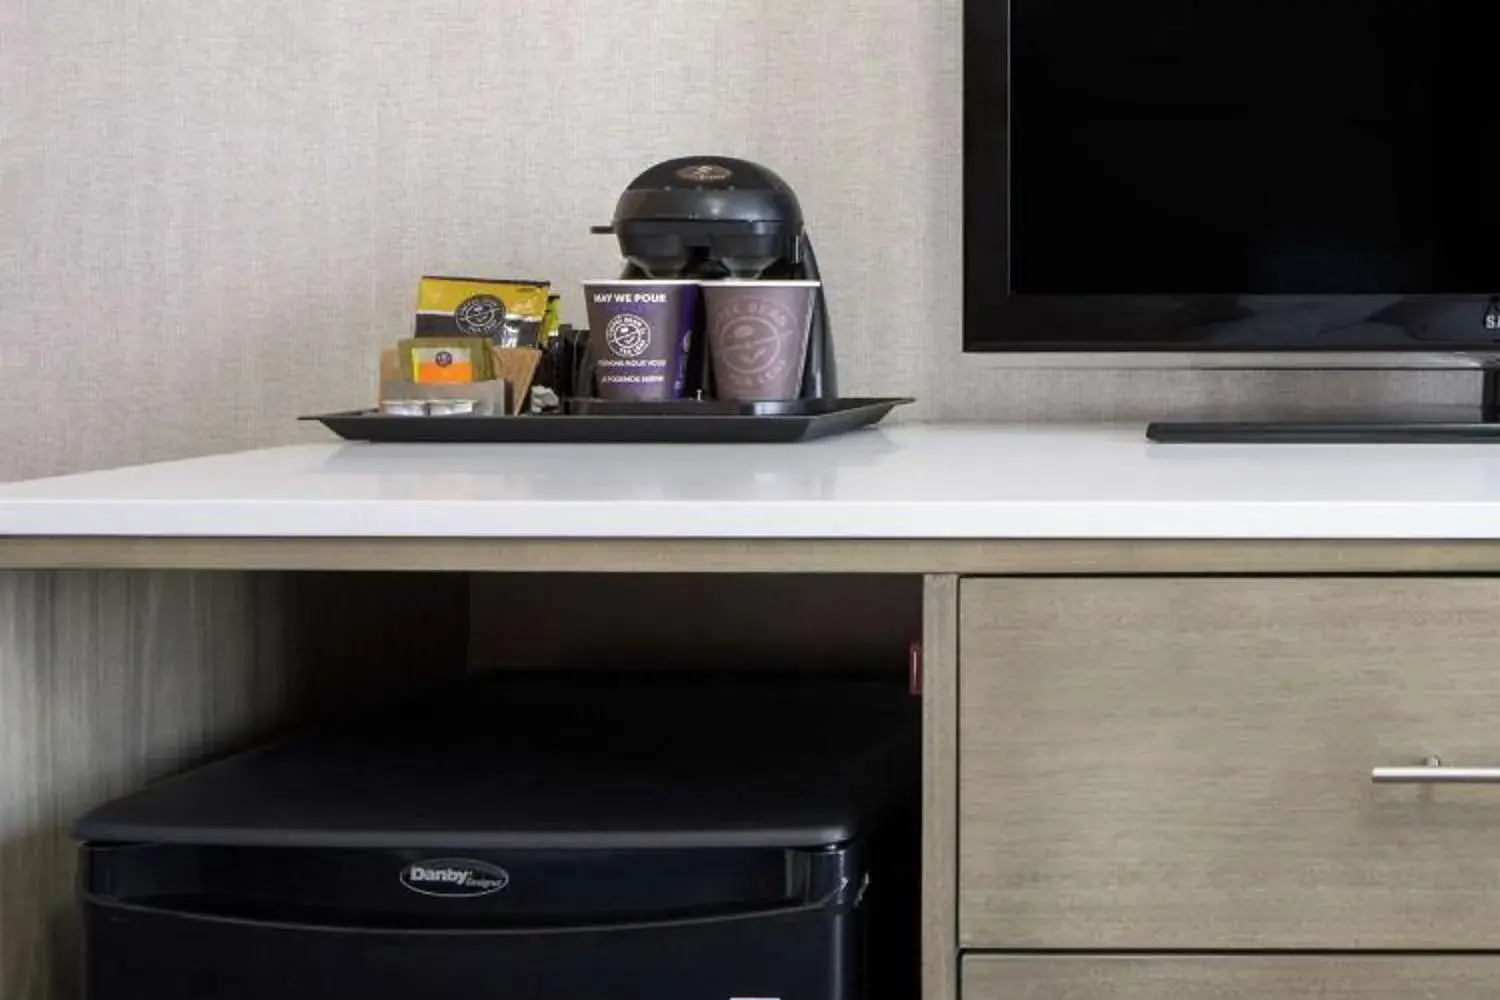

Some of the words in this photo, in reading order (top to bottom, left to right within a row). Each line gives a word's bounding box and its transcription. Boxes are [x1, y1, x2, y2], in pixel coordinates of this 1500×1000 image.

[593, 293, 613, 303] MAY
[613, 293, 633, 303] WE
[633, 293, 668, 303] POUR
[410, 867, 468, 885] Danby
